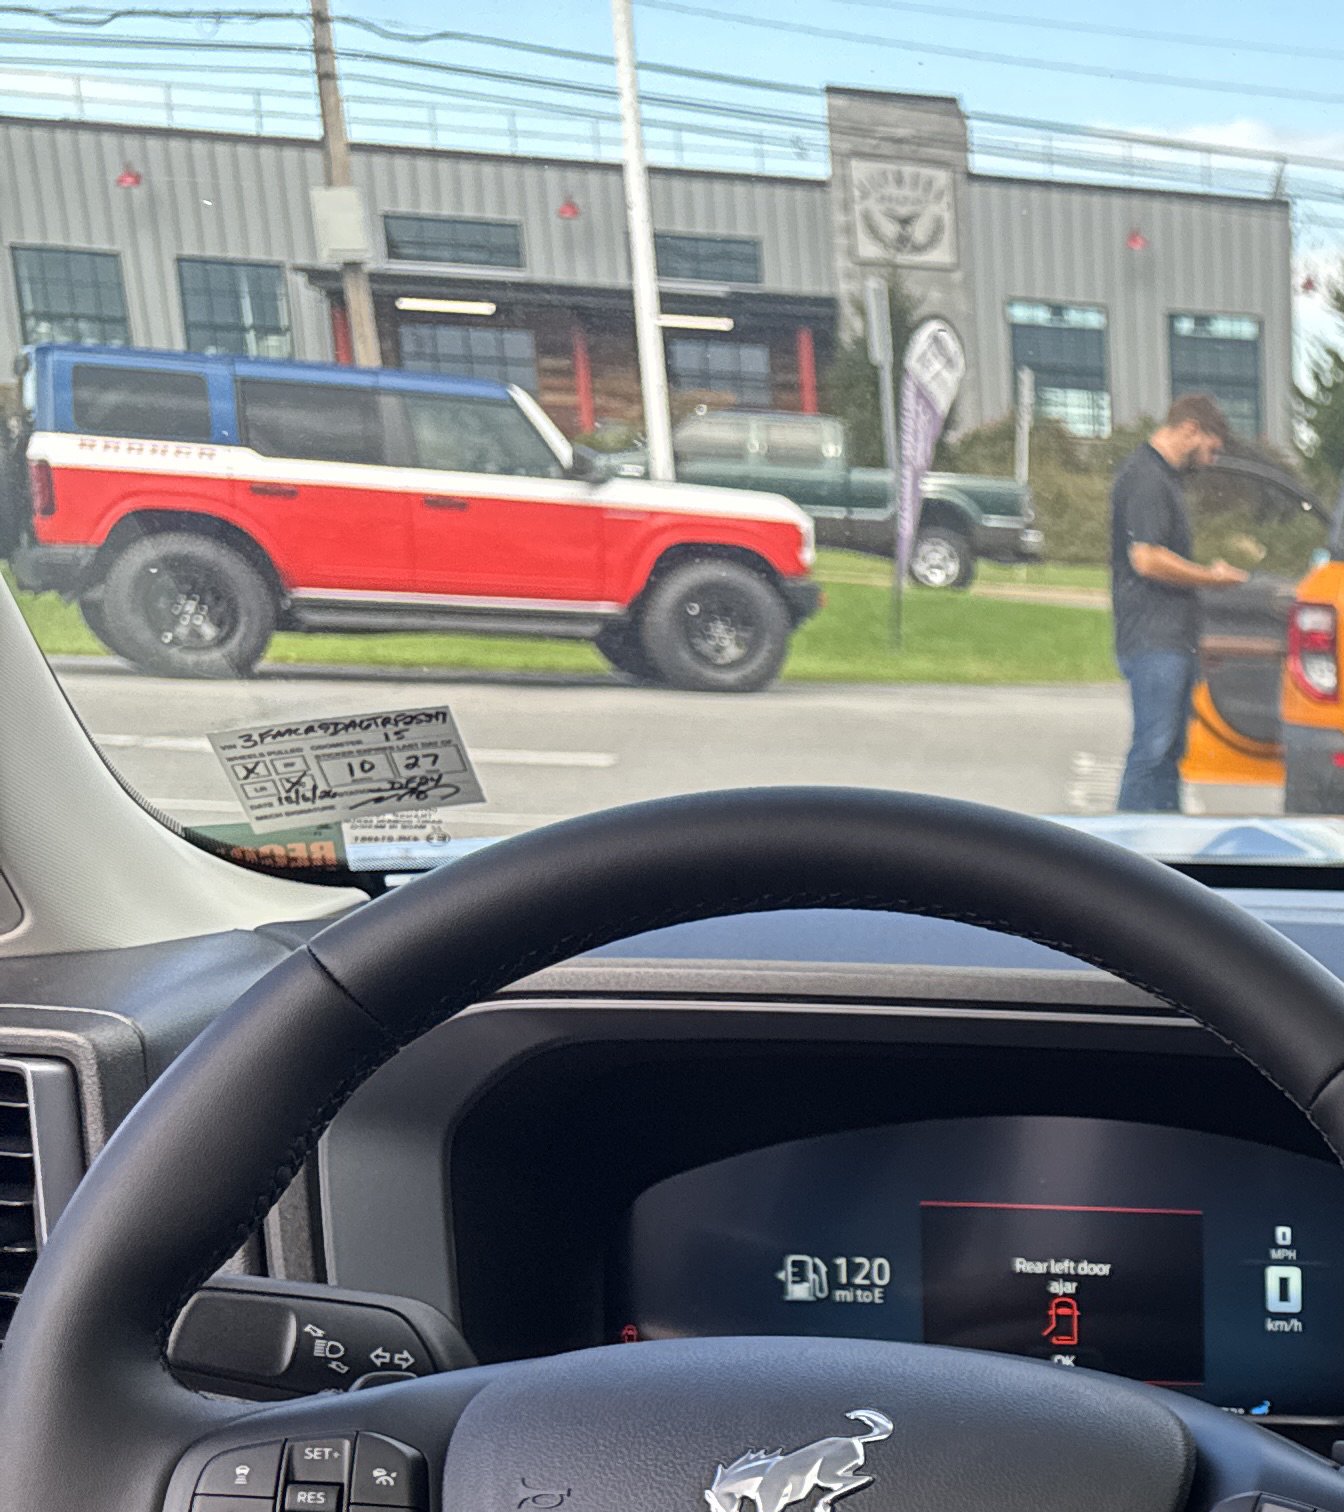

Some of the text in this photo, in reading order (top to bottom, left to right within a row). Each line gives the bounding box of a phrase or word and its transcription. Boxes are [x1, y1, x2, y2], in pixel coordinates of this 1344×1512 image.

[347, 759, 375, 778] 10
[404, 753, 439, 770] 27
[1269, 1248, 1297, 1260] MPH
[833, 1256, 892, 1286] 120
[1012, 1257, 1112, 1277] Rear left door
[832, 1288, 854, 1302] mi
[855, 1288, 873, 1302] to
[1048, 1279, 1078, 1297] ajar
[1265, 1317, 1303, 1332] km/h
[296, 1491, 326, 1504] RES
